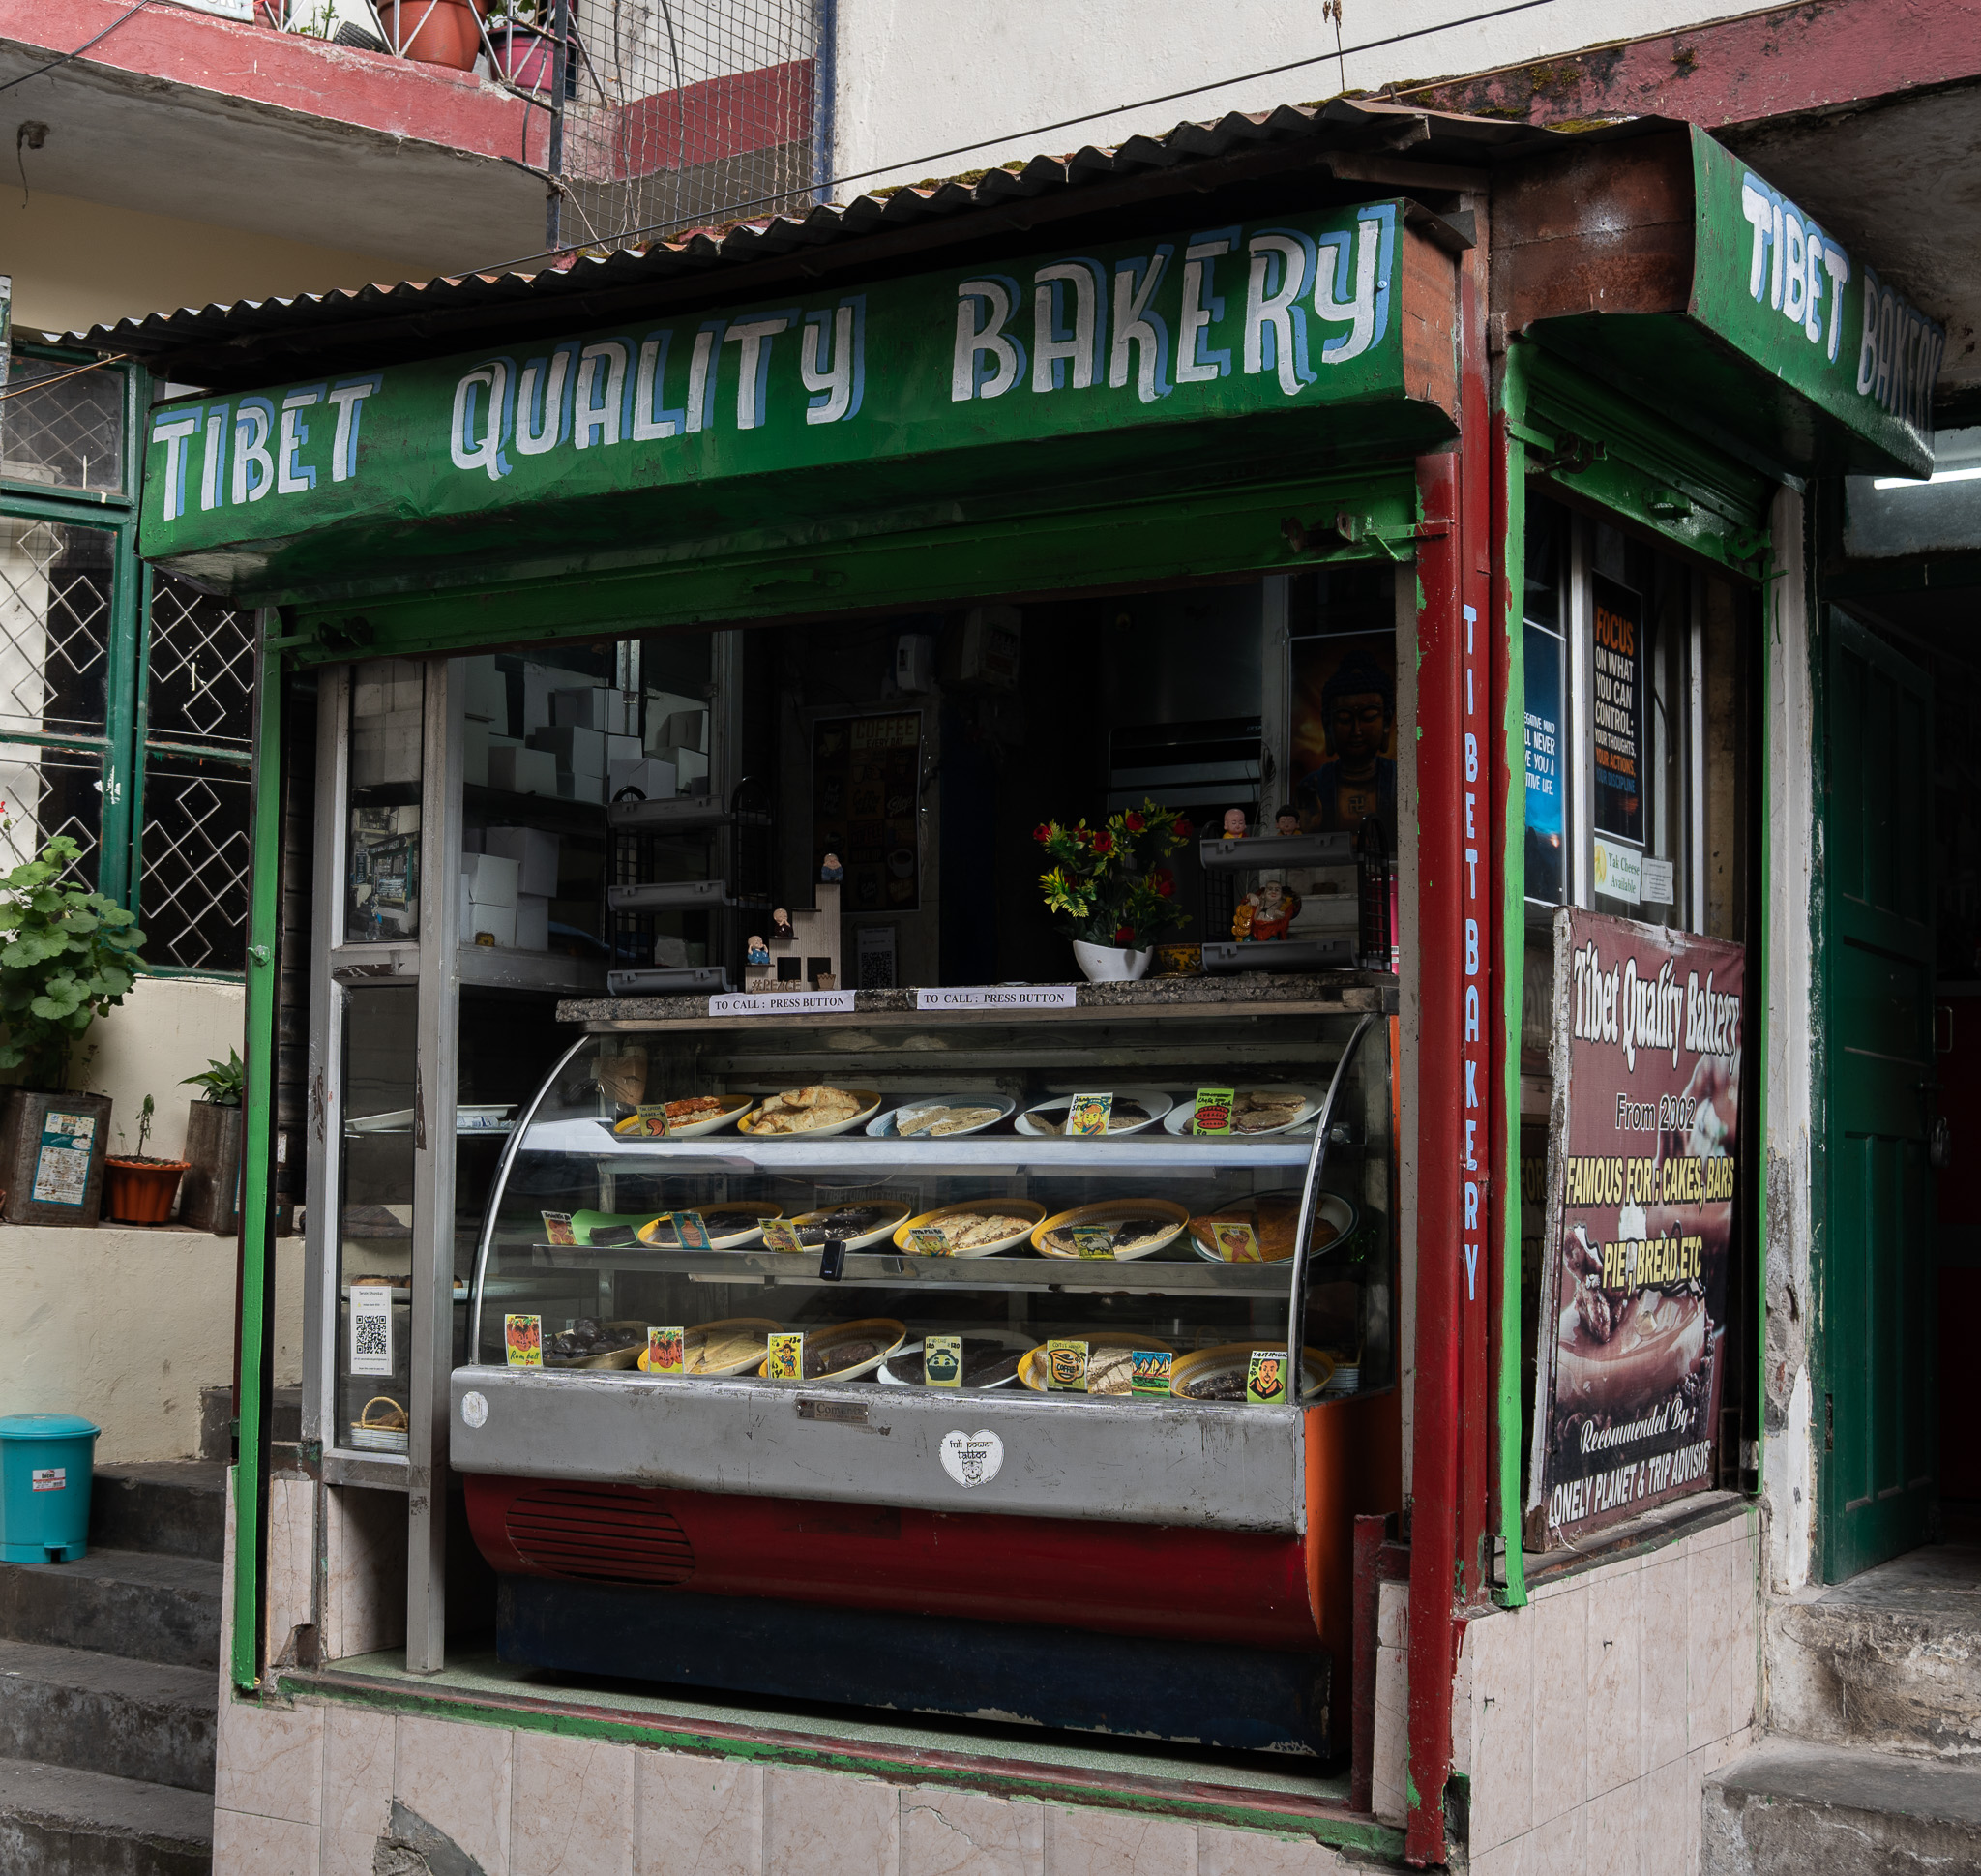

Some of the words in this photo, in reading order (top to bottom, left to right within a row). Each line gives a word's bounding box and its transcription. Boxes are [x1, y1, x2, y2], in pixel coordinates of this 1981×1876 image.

[1742, 172, 1849, 364] TIBET
[1856, 265, 1944, 435] BAKERY
[153, 374, 383, 521] TIBET
[451, 294, 866, 480] QUALITY
[952, 204, 1396, 403] BAKERY
[1596, 605, 1634, 656] FOCUS
[1596, 646, 1608, 672] ON
[1608, 653, 1634, 682] WHAT
[1596, 674, 1611, 700] YOU
[1613, 682, 1632, 709] CAN
[1524, 712, 1542, 730] EGATIVE
[1595, 728, 1608, 746] YOUR
[1464, 604, 1478, 899] TIBET
[1534, 731, 1555, 756] NEVER
[1596, 748, 1609, 767] YOUR
[1534, 753, 1549, 774] YOU
[1550, 759, 1554, 777] A
[1608, 852, 1619, 869] Yak
[1620, 857, 1640, 876] Cheese
[1611, 875, 1637, 894] Available
[751, 979, 802, 992] #PEACE
[924, 994, 938, 1003] TO
[984, 993, 1017, 1003] PRESS
[1019, 993, 1065, 1003] BUTTON
[715, 1000, 728, 1010] TO
[770, 998, 800, 1008] PRESS
[803, 998, 844, 1008] BUTTON
[1574, 938, 1620, 1045] Tibet
[1622, 956, 1683, 1073] Quality
[1685, 970, 1740, 1076] Bakery
[1464, 919, 1479, 1300] BAKERY
[1615, 1093, 1655, 1131] From
[1659, 1094, 1696, 1131] 2002
[1565, 1155, 1623, 1207] FAMOUS
[1705, 1156, 1734, 1203] BARS
[1636, 1237, 1678, 1288] BREAD
[1680, 1235, 1702, 1281] ETC
[511, 1350, 524, 1360] Rum
[1580, 1402, 1671, 1454] Recommended
[958, 1450, 987, 1459] tattoo
[1549, 1475, 1593, 1529] LONELY
[1593, 1463, 1637, 1514] PLANET
[1637, 1460, 1645, 1500] &
[1648, 1452, 1671, 1495] TRIP
